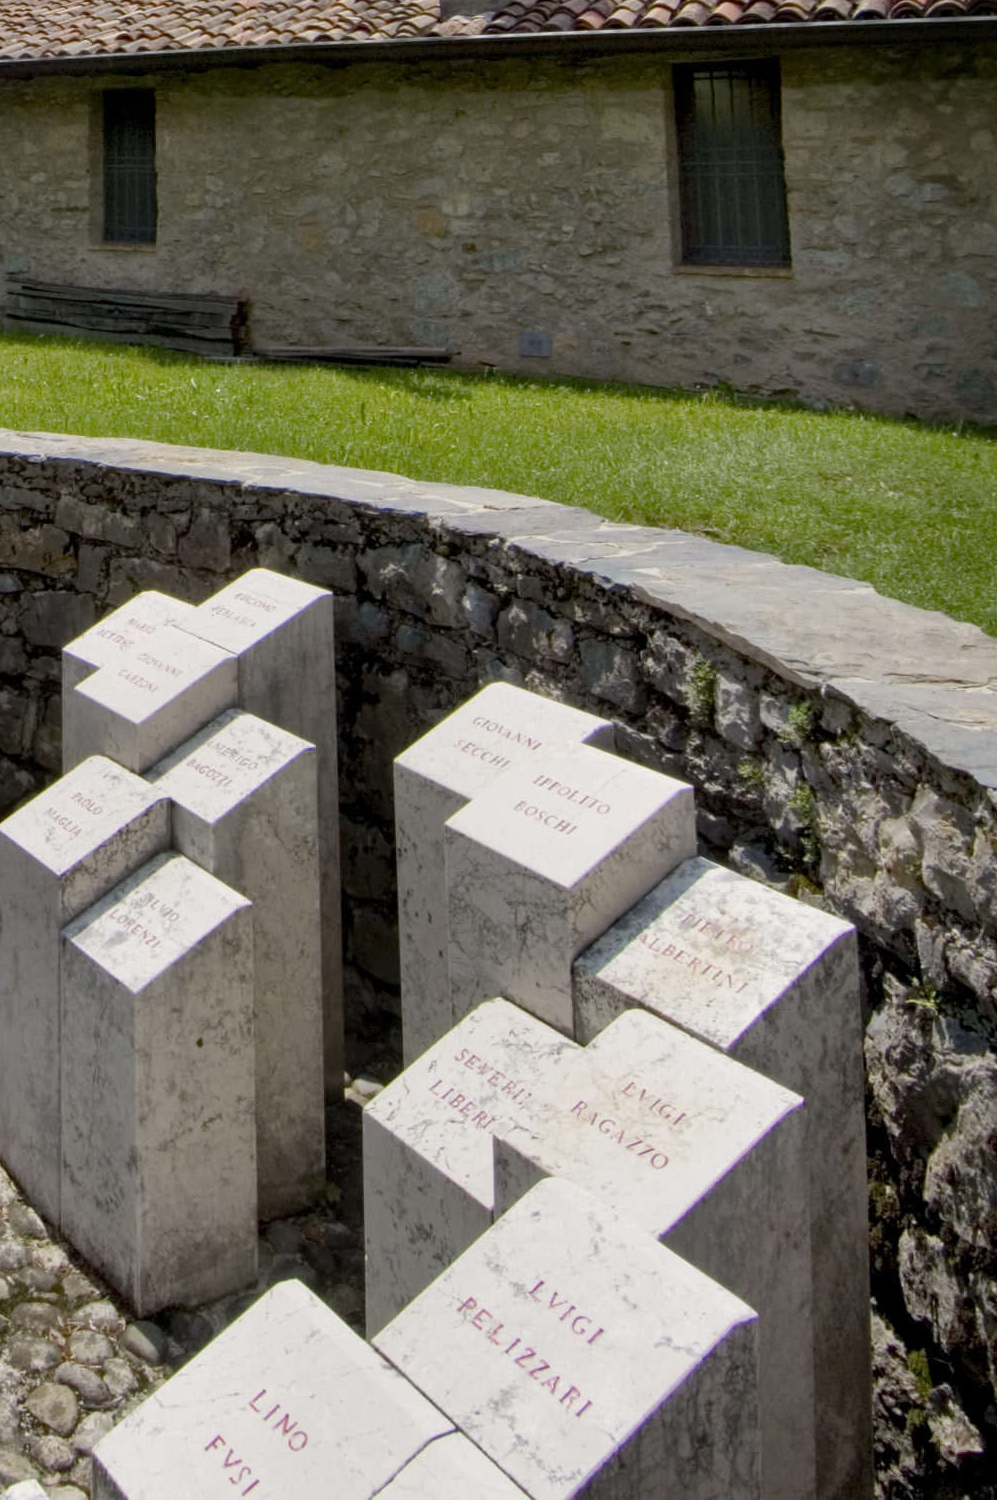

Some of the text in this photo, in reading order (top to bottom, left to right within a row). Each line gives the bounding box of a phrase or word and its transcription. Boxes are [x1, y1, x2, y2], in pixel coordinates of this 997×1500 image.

[117, 668, 160, 693] GARZONI
[137, 653, 183, 678] GIOVANNI
[472, 715, 543, 751] GIOVANNI
[186, 758, 233, 787] BAGOZZI
[206, 740, 259, 771] AMERIGO
[452, 737, 511, 771] SECCHI
[71, 791, 104, 817] PAOLO
[532, 773, 612, 816] IPPOLITO
[43, 807, 82, 837] MAGLIA
[513, 799, 580, 837] BOSCHI
[139, 892, 180, 922] SILVIO
[109, 908, 161, 949] LORENZI
[681, 911, 755, 954] PIETRO
[638, 932, 749, 995] ALBERTINI
[621, 1080, 688, 1127] LVIGI
[570, 1100, 670, 1171] RAGAZZO
[528, 1280, 604, 1345] LVIGI
[457, 1297, 593, 1418] PELIZZARI
[249, 1388, 309, 1453] LINO
[204, 1434, 260, 1497] FVSI
